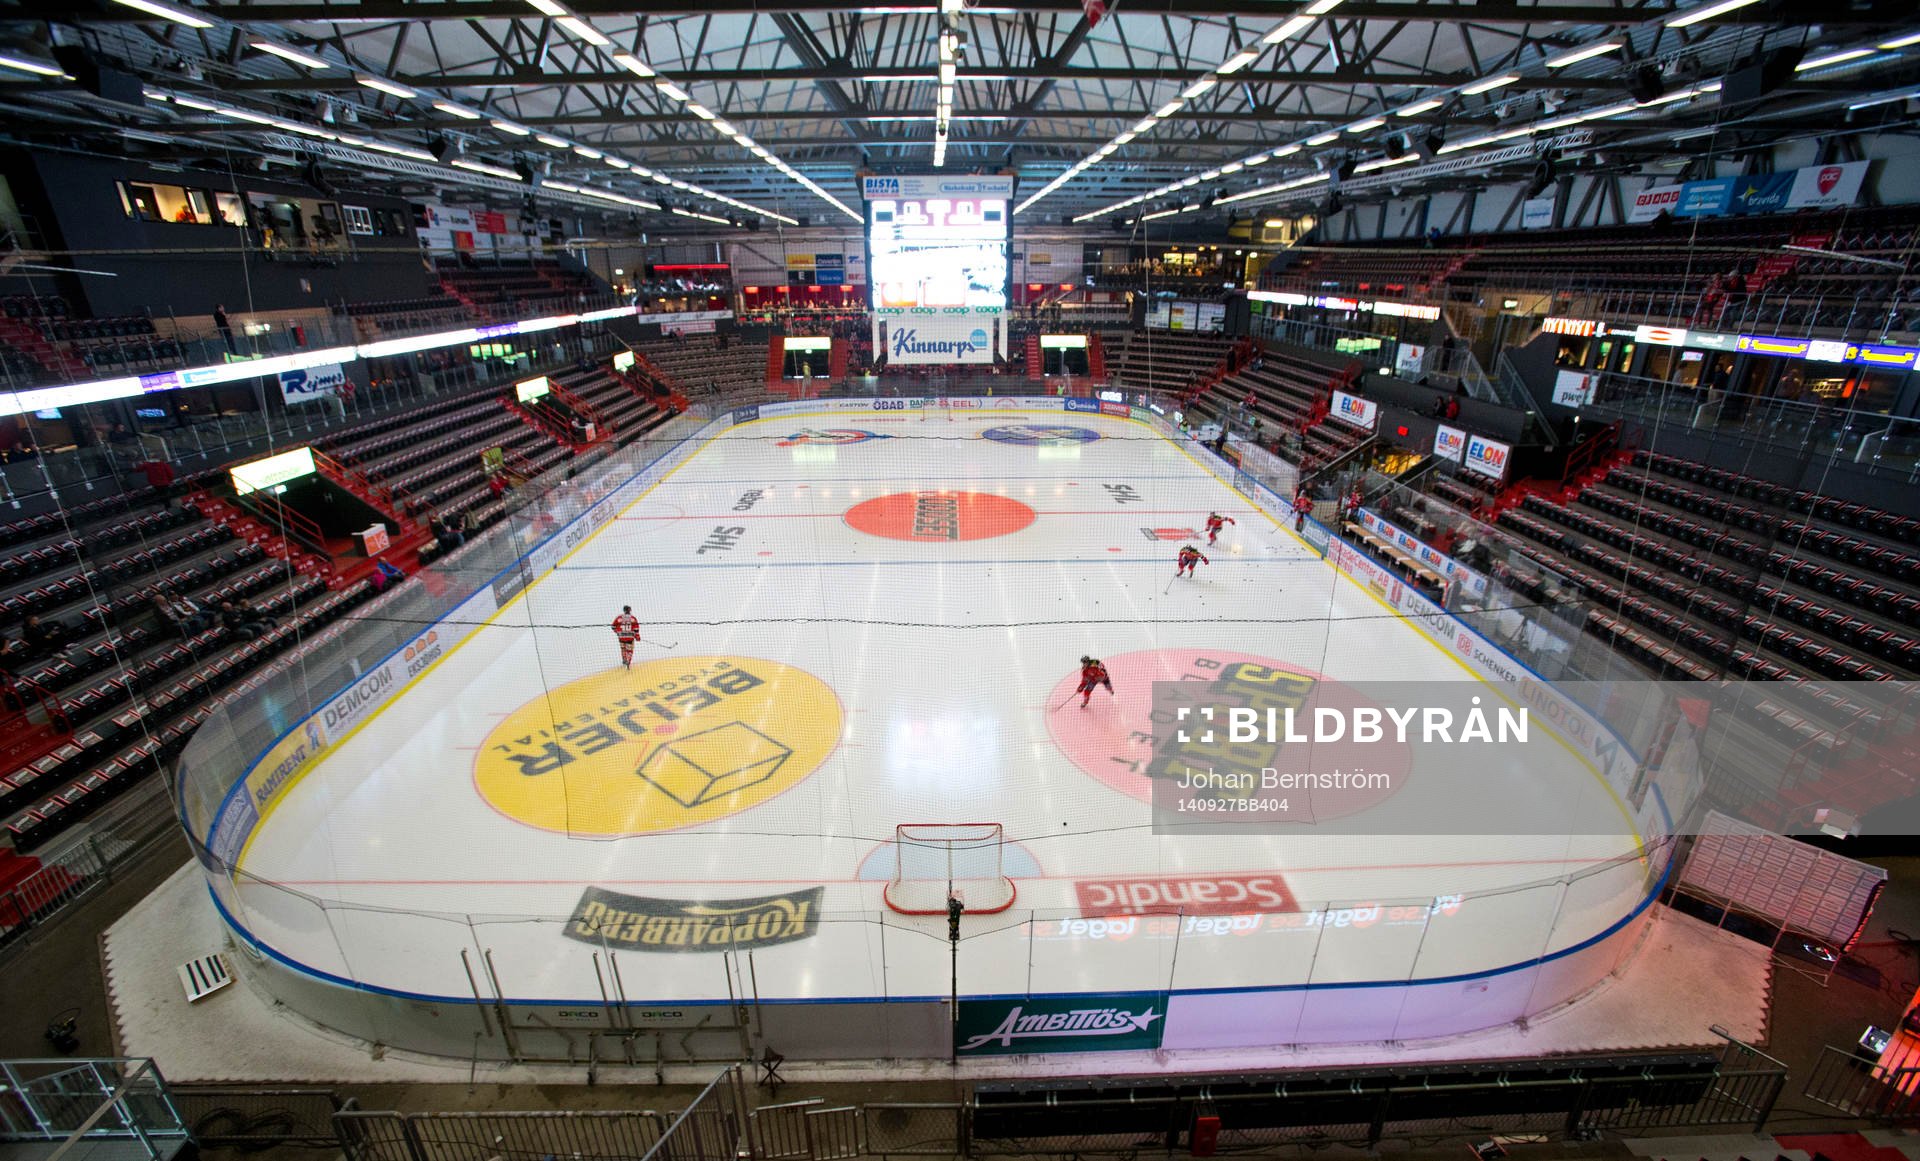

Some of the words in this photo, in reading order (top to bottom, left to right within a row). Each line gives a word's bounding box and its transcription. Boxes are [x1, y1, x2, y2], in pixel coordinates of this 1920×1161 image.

[865, 178, 899, 188] BISTA
[1748, 193, 1780, 206] bravida
[878, 307, 904, 316] coop
[910, 307, 937, 316] coop
[943, 306, 970, 316] coop
[975, 306, 1002, 315] coop
[892, 327, 976, 359] Kinnarps
[873, 398, 904, 410] ÖBAB
[1341, 396, 1367, 418] ELON
[1438, 431, 1462, 449] ELON
[1469, 441, 1507, 468] ELON
[696, 526, 745, 554] SHL
[1399, 533, 1418, 551] ELON
[1421, 546, 1442, 568] ELON
[1406, 595, 1456, 640] DEMCOM
[1474, 649, 1517, 685] SCHENKER
[324, 665, 393, 729] DEMCOM
[492, 660, 732, 753] BYGGMATERIAL
[506, 667, 765, 777] BEIJER
[1519, 679, 1594, 748] LINOTOL
[255, 744, 306, 806] RAMIRENT
[1087, 879, 1283, 913] Scandic
[575, 899, 811, 946] KOPPARBERG
